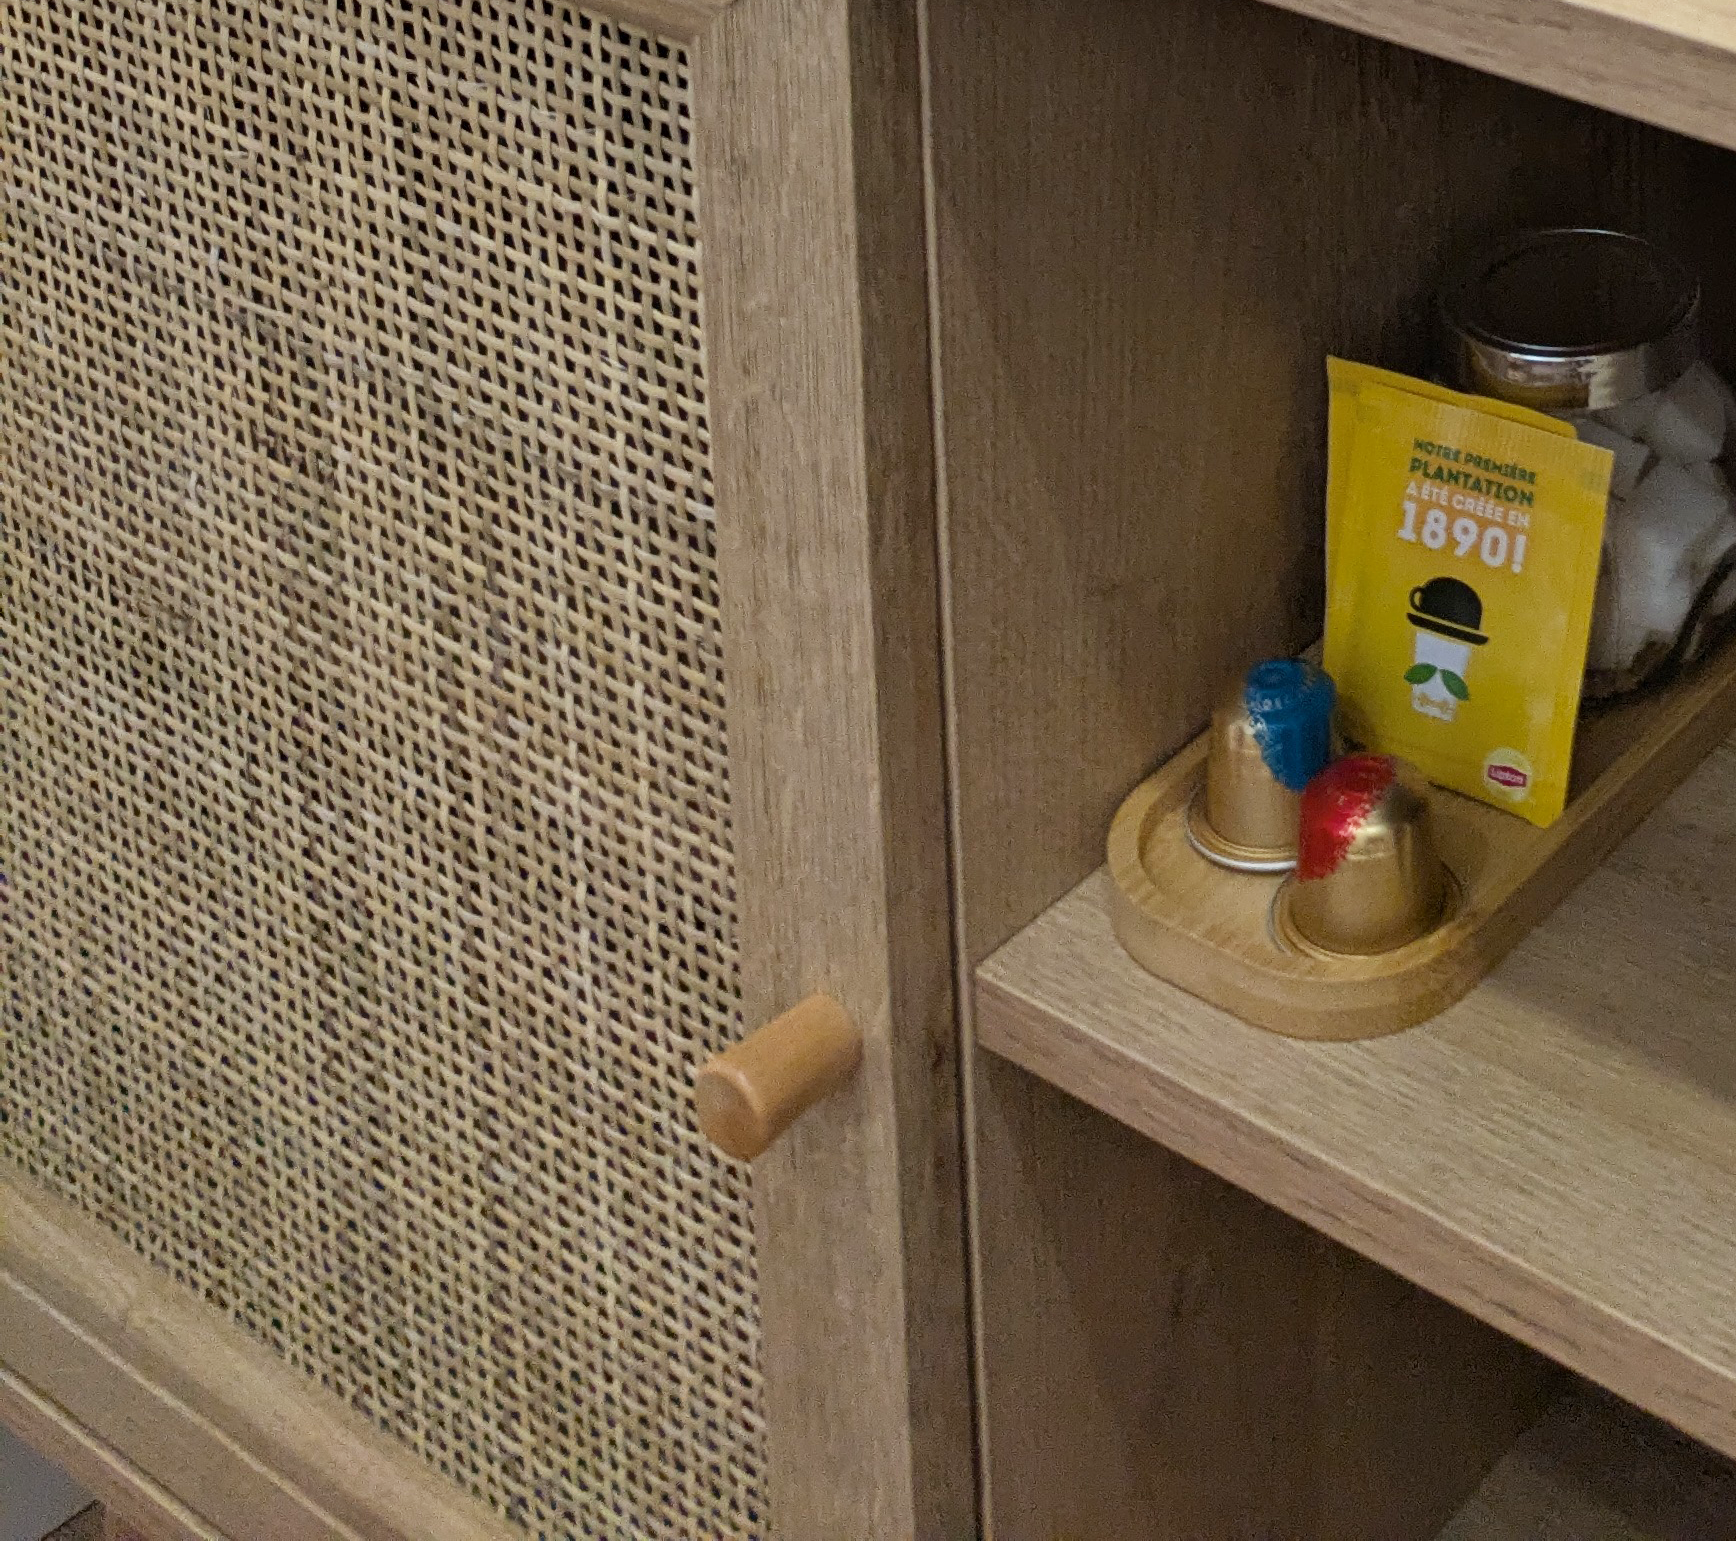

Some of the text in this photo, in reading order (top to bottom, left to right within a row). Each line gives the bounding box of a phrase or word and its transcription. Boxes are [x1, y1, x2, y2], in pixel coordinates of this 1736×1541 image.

[1413, 438, 1460, 463] NOTRE
[1406, 481, 1417, 496] A
[1508, 510, 1530, 528] EN
[1409, 457, 1534, 508] PLANTATION
[1398, 500, 1528, 574] 1890!
